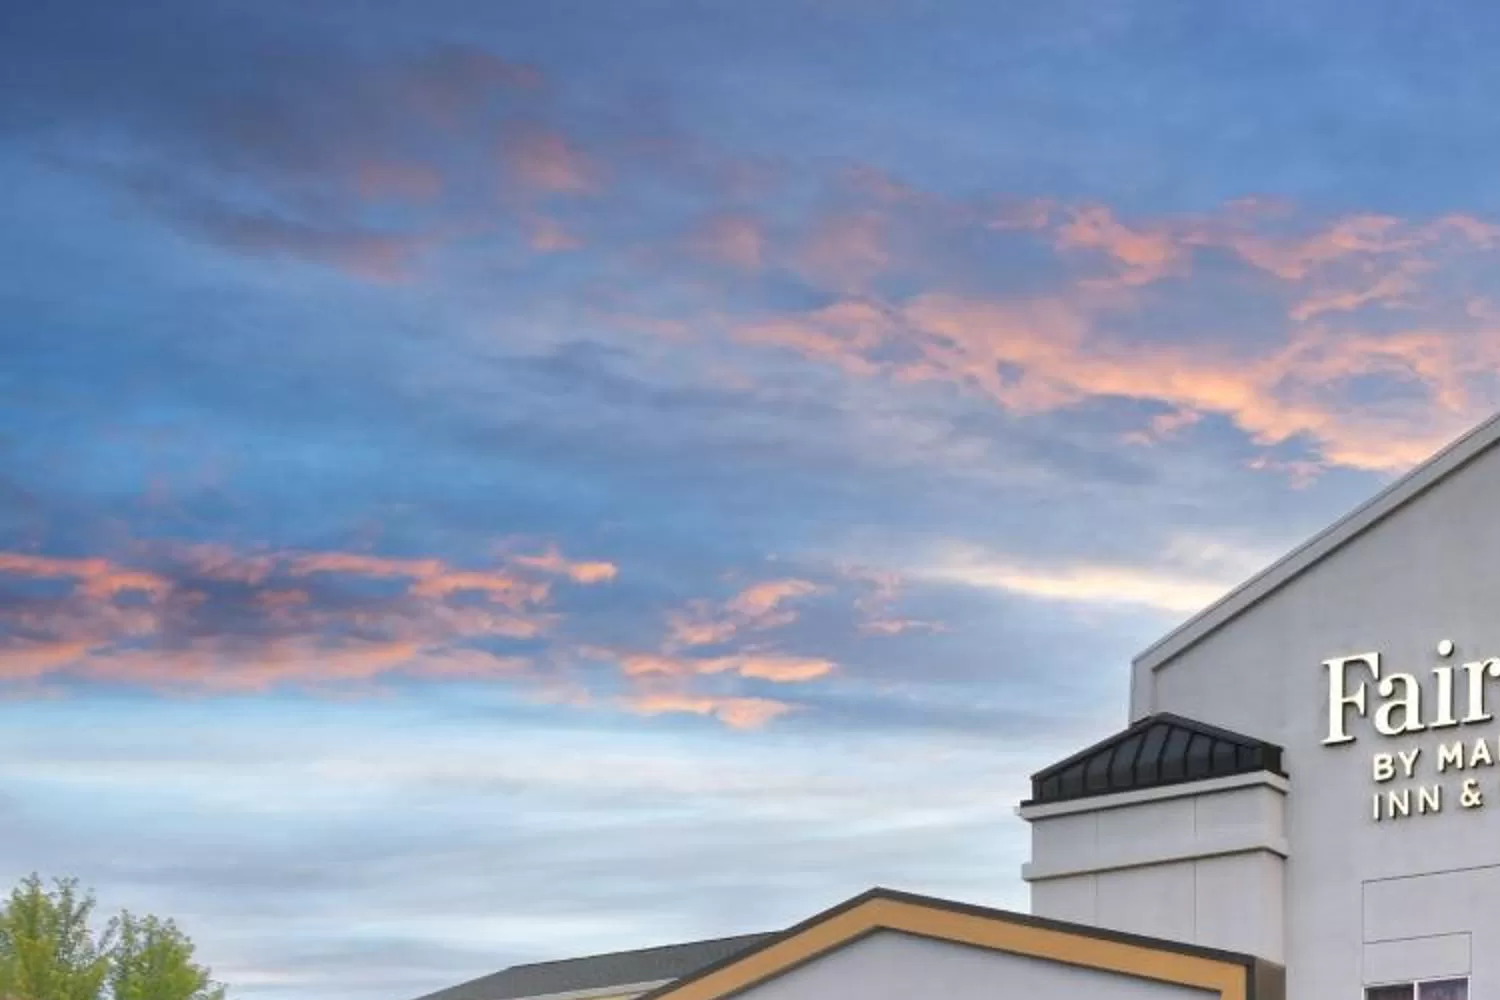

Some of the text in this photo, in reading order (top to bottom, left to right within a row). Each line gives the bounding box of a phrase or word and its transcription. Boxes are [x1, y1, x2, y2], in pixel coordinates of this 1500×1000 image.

[1373, 747, 1421, 782] BY
[1373, 784, 1441, 820] INN
[1460, 778, 1483, 808] &
